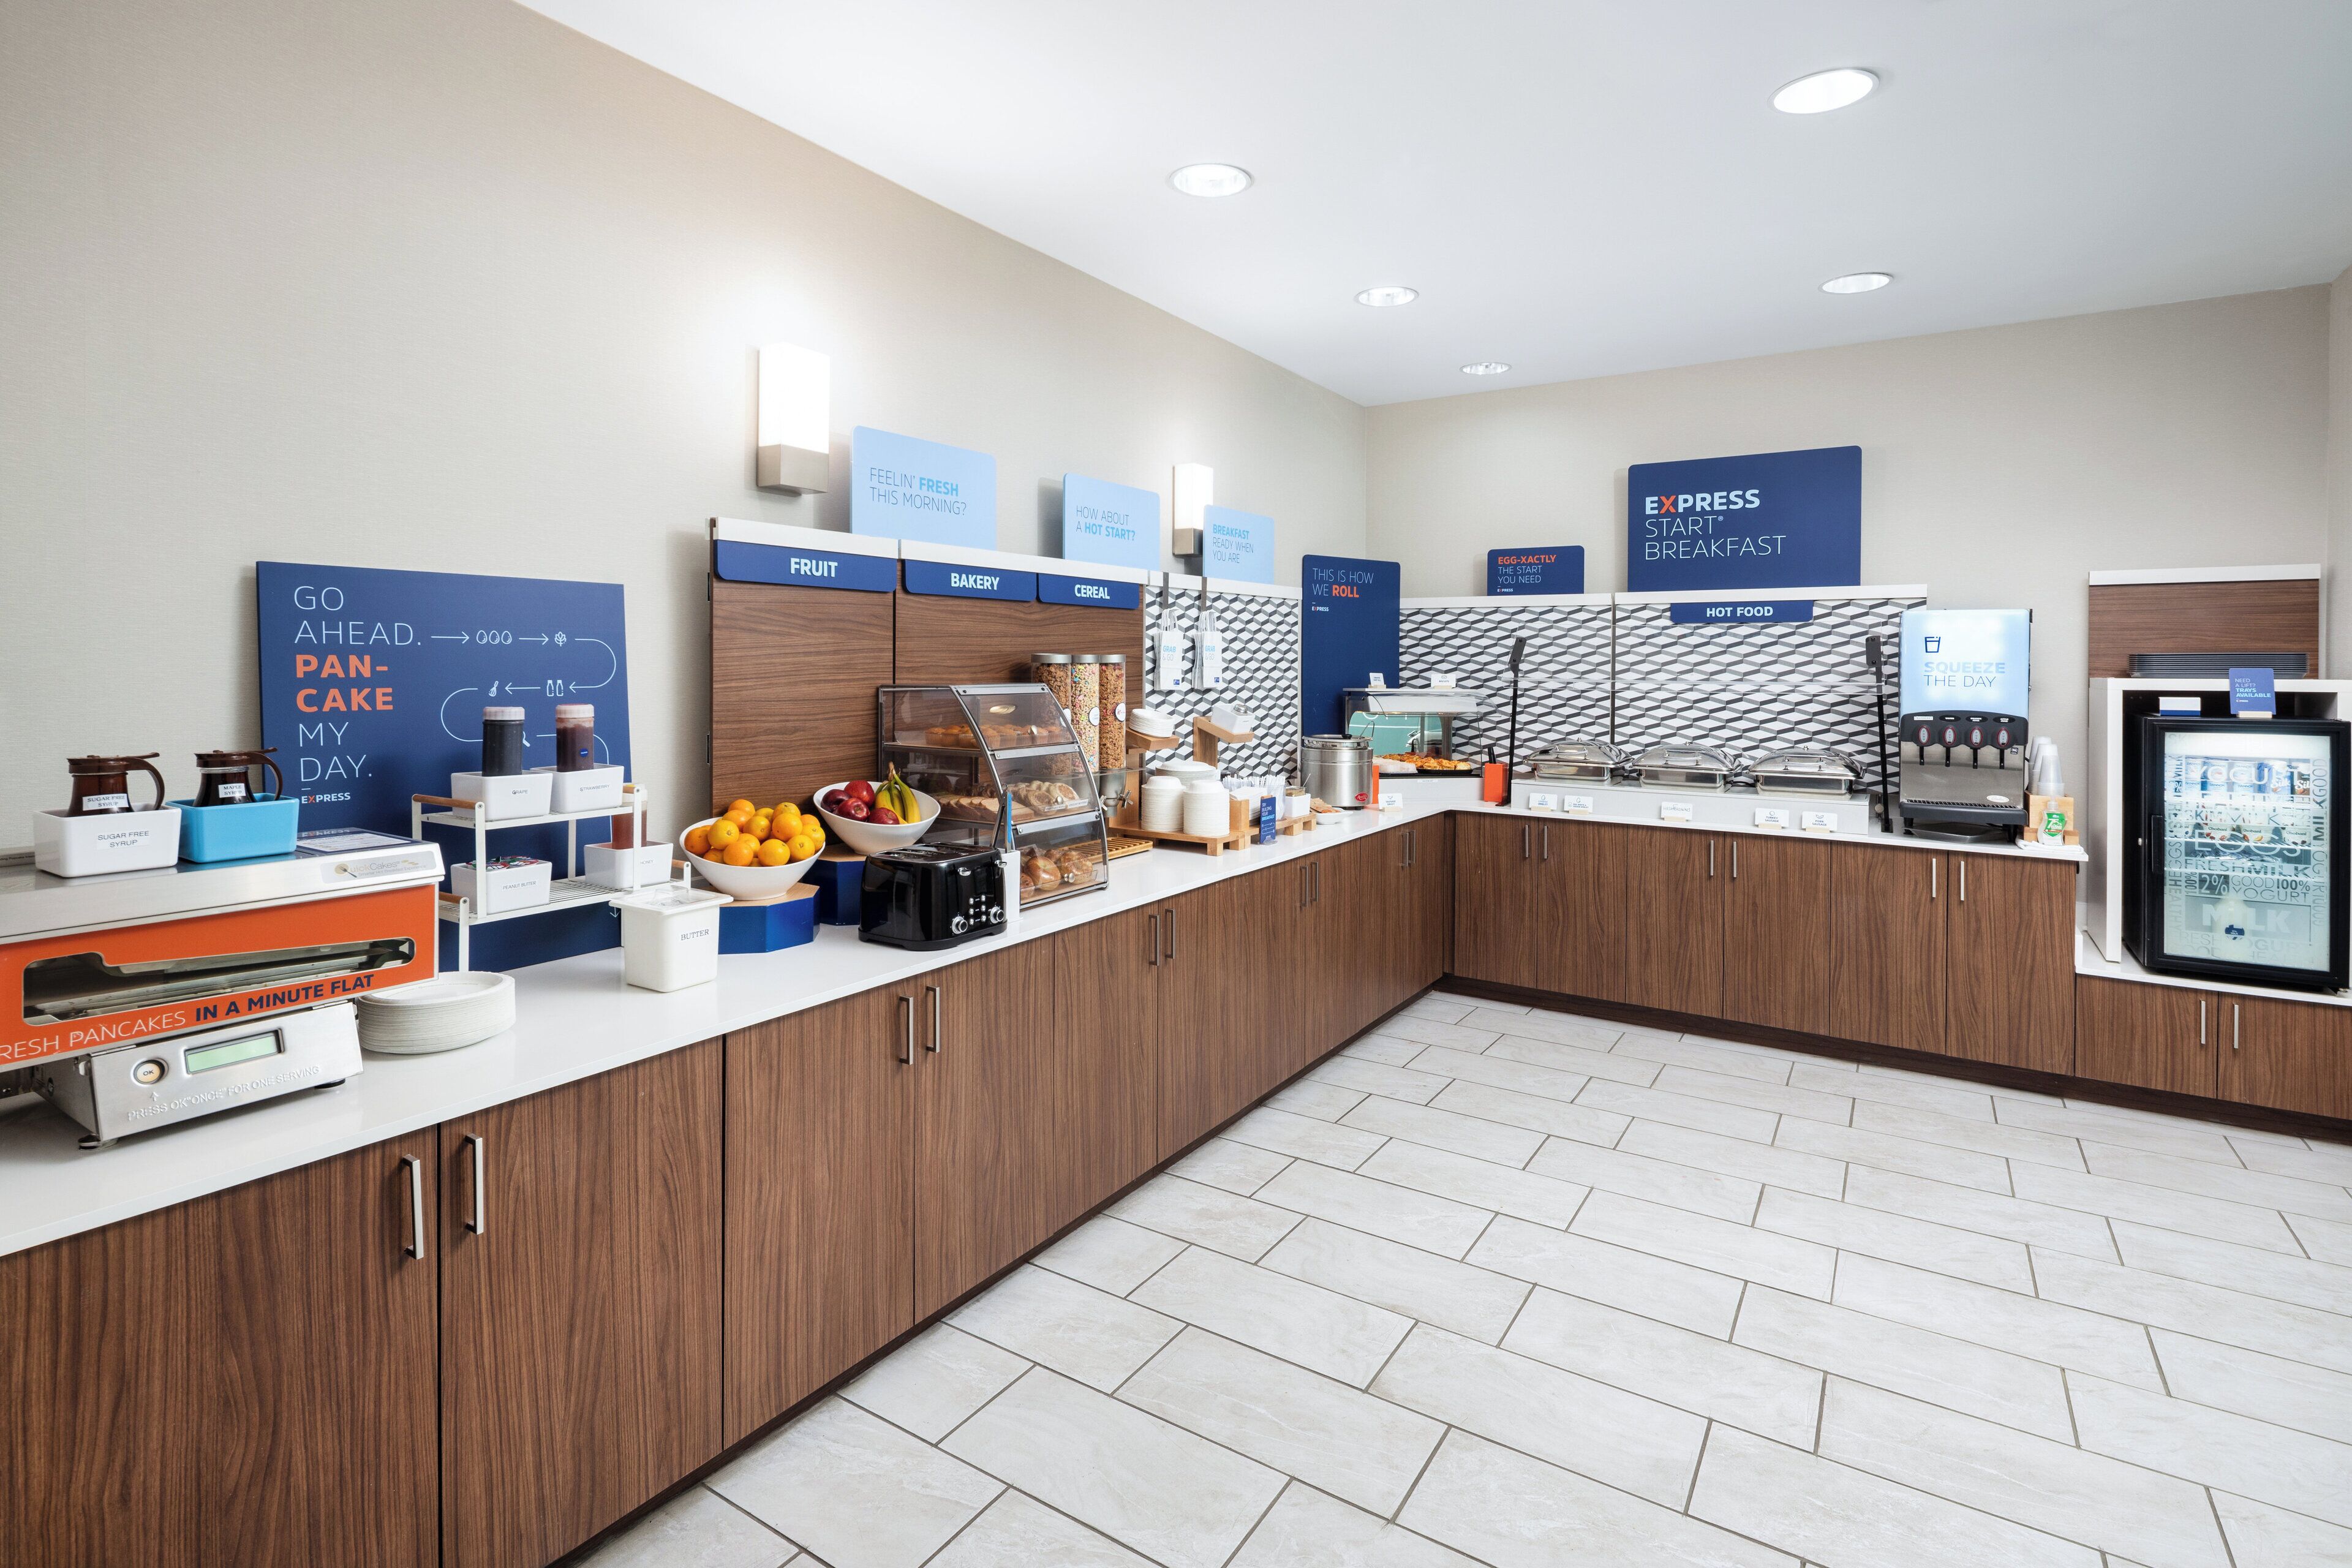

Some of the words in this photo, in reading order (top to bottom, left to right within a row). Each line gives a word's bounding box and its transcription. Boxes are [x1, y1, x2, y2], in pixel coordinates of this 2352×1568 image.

[919, 477, 959, 497] FRESH
[870, 486, 898, 505] THIS
[903, 492, 967, 516] MORNING?
[1645, 489, 1760, 515] EXPRESS
[1077, 505, 1098, 520] HOW
[1101, 510, 1129, 526] ABOUT
[1076, 521, 1082, 532] A
[1085, 522, 1102, 535] HOT
[1106, 526, 1136, 541] START?
[1213, 524, 1250, 540] BREAKFAST
[1213, 537, 1234, 549] READY
[1235, 541, 1254, 553] WHEN
[1646, 535, 1786, 560] BREAKFAST
[1213, 549, 1226, 561] YOU
[1228, 552, 1240, 564] ARE
[1498, 554, 1556, 564] EGG-XACTLY
[790, 557, 838, 577] FRUIT
[1313, 568, 1334, 581] THIS
[1338, 570, 1346, 582] IS
[1349, 571, 1374, 584] HOW
[1517, 565, 1542, 574] START
[951, 573, 1000, 590] BAKERY
[1312, 584, 1329, 596] WE
[1332, 585, 1359, 598] ROLL
[295, 586, 344, 610] GO
[1074, 584, 1110, 600] CEREAL
[1706, 607, 1733, 617] HOT
[1737, 606, 1773, 617] FOOD
[295, 620, 421, 645] AHEAD.
[296, 654, 388, 678] PAN-
[1924, 662, 2005, 674] SQUEEZE
[1923, 675, 1956, 687] THE
[1964, 676, 1996, 687] DAY
[296, 687, 393, 712] CAKE
[300, 722, 349, 747] MY
[301, 755, 371, 782] DAY.
[2312, 758, 2328, 797] GOOD
[2294, 780, 2309, 790] Sil
[301, 793, 350, 804] EXPRESS
[2201, 874, 2228, 894] 2%
[2231, 875, 2274, 888] GOOD
[2277, 878, 2310, 892] 100%
[2233, 887, 2309, 903] YOGURT
[2203, 903, 2291, 934] MLK
[681, 929, 709, 941] BUTTER
[0, 1035, 59, 1059] RESH
[69, 1011, 186, 1047] PANCAKES
[196, 1005, 217, 1022] IN
[225, 1001, 240, 1016] A
[247, 984, 323, 1011] MINUTE
[331, 974, 374, 994] FLAT
[127, 1104, 167, 1121] PRESS
[227, 1083, 250, 1096] FOR
[251, 1076, 275, 1090] ONE
[276, 1065, 320, 1083] SERVING
